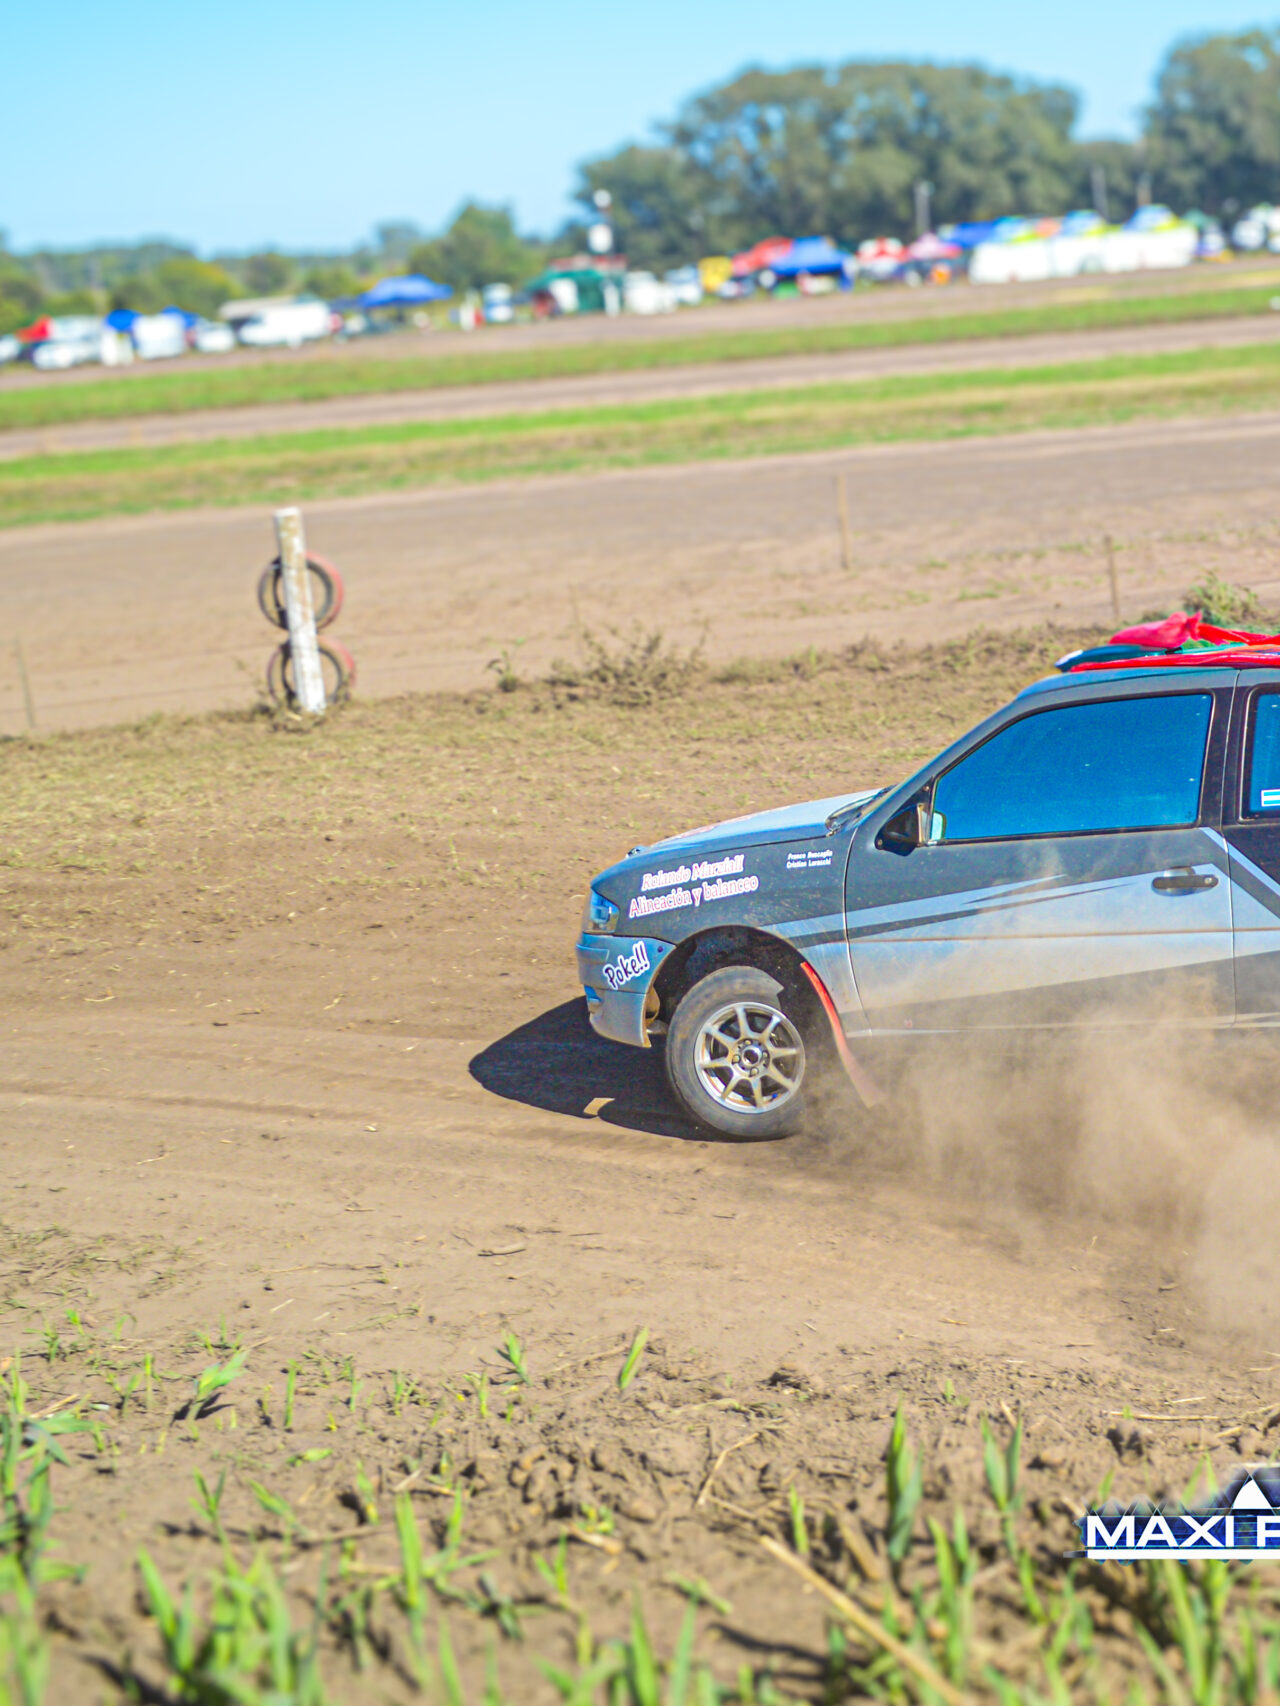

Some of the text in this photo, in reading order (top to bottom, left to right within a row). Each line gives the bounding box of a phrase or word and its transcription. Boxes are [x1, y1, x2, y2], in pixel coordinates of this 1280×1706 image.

[629, 875, 758, 918] Alineación y balanceo
[641, 866, 692, 891] Rolando
[603, 941, 650, 990] Poke!!
